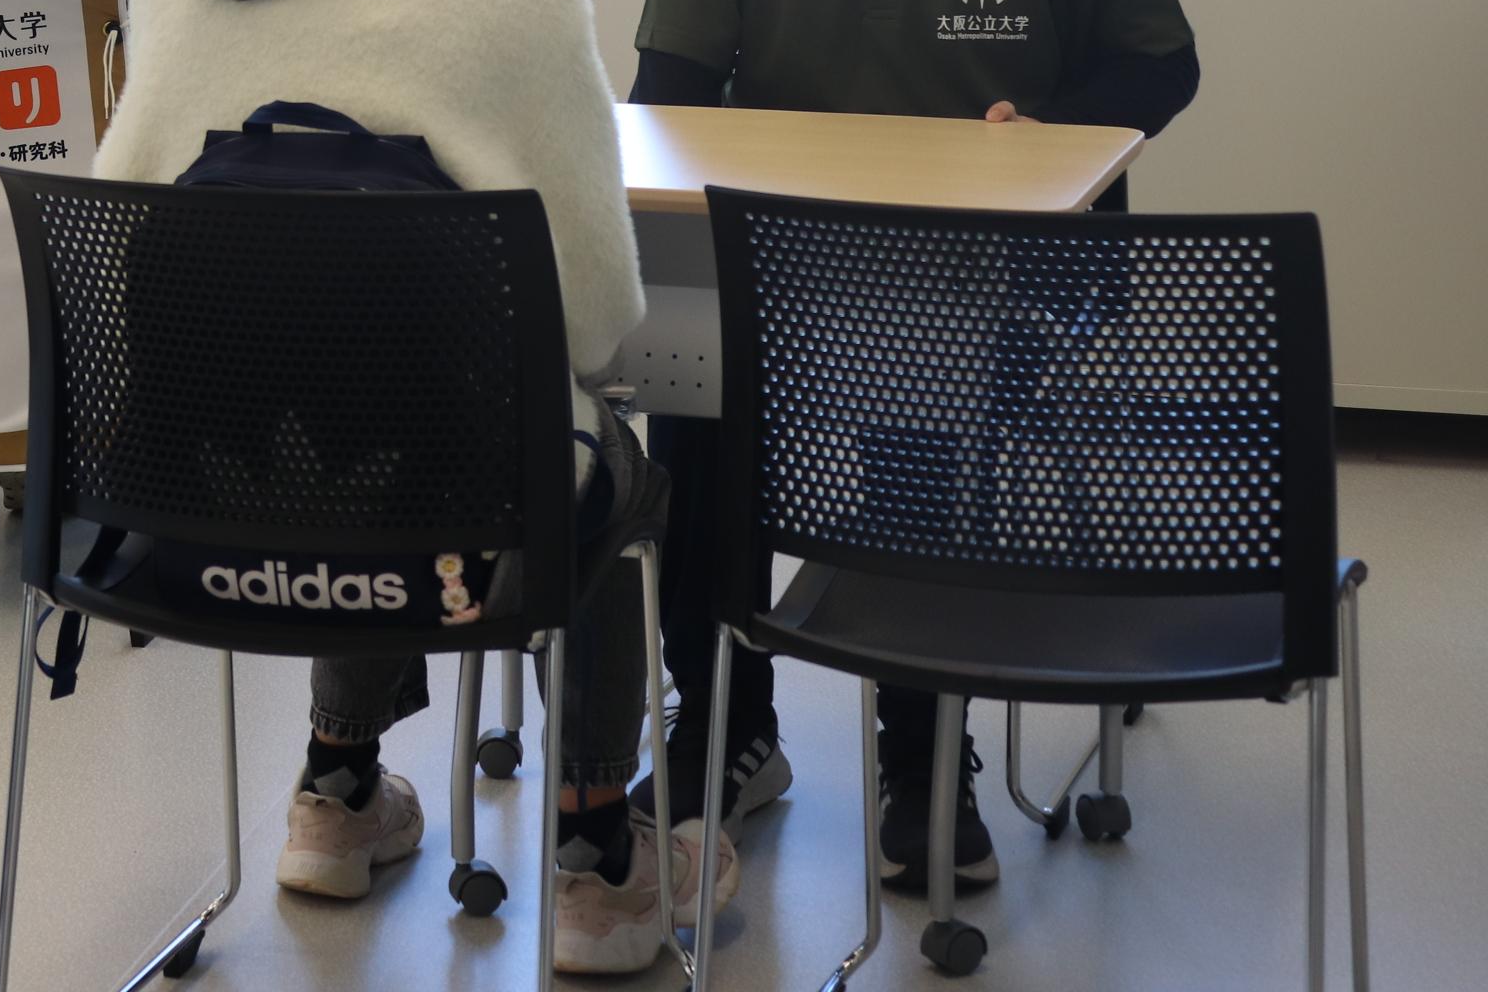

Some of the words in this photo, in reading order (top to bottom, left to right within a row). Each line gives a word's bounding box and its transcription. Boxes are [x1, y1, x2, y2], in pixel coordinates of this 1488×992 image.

[936, 14, 1030, 32] 大阪公立大学
[937, 32, 956, 40] Osaka
[957, 32, 995, 41] Metropolitan
[996, 32, 1029, 41] University
[200, 560, 408, 610] adidas
